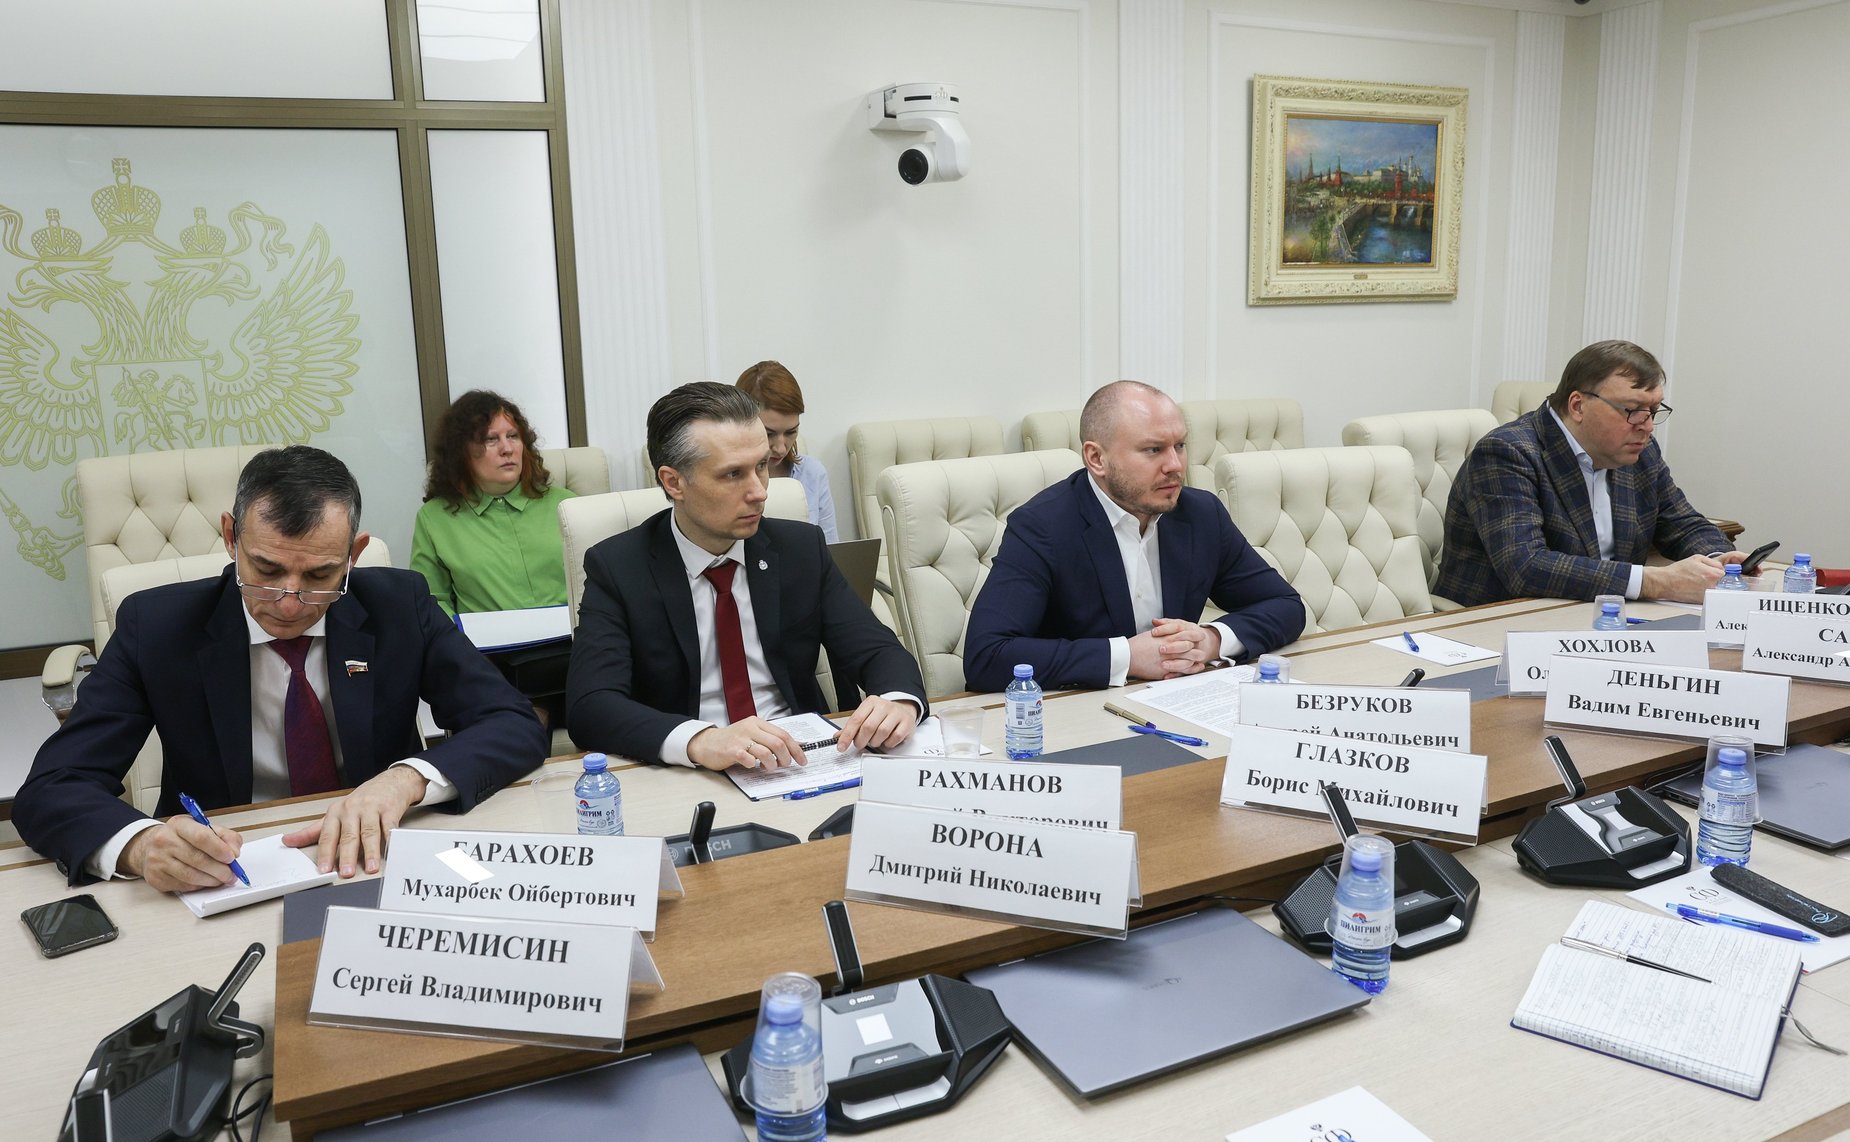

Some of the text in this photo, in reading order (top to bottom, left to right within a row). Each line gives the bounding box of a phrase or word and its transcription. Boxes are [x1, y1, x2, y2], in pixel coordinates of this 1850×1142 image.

[1760, 599, 1850, 616] ИЩЕНКО
[1558, 639, 1656, 653] ХОХЛОВА
[1752, 647, 1834, 668] Александр
[1607, 669, 1721, 695] ДЕНЬГИН
[1296, 694, 1412, 714] БЕЗРУКОВ
[1568, 694, 1760, 731] Вадим Евгеньевич
[1295, 742, 1410, 774] ГЛАЗКОВ
[918, 769, 1062, 794] РАХМАНОВ
[1246, 769, 1309, 794] Борис
[931, 823, 1043, 858] ВОРОНА
[402, 878, 635, 909] Мухарбек Ойбертович
[868, 854, 1101, 906] Дмитрий Николаевич
[378, 924, 569, 964] ЧЕРЕМИСИН
[332, 967, 602, 1013] Сергей Владимирович
